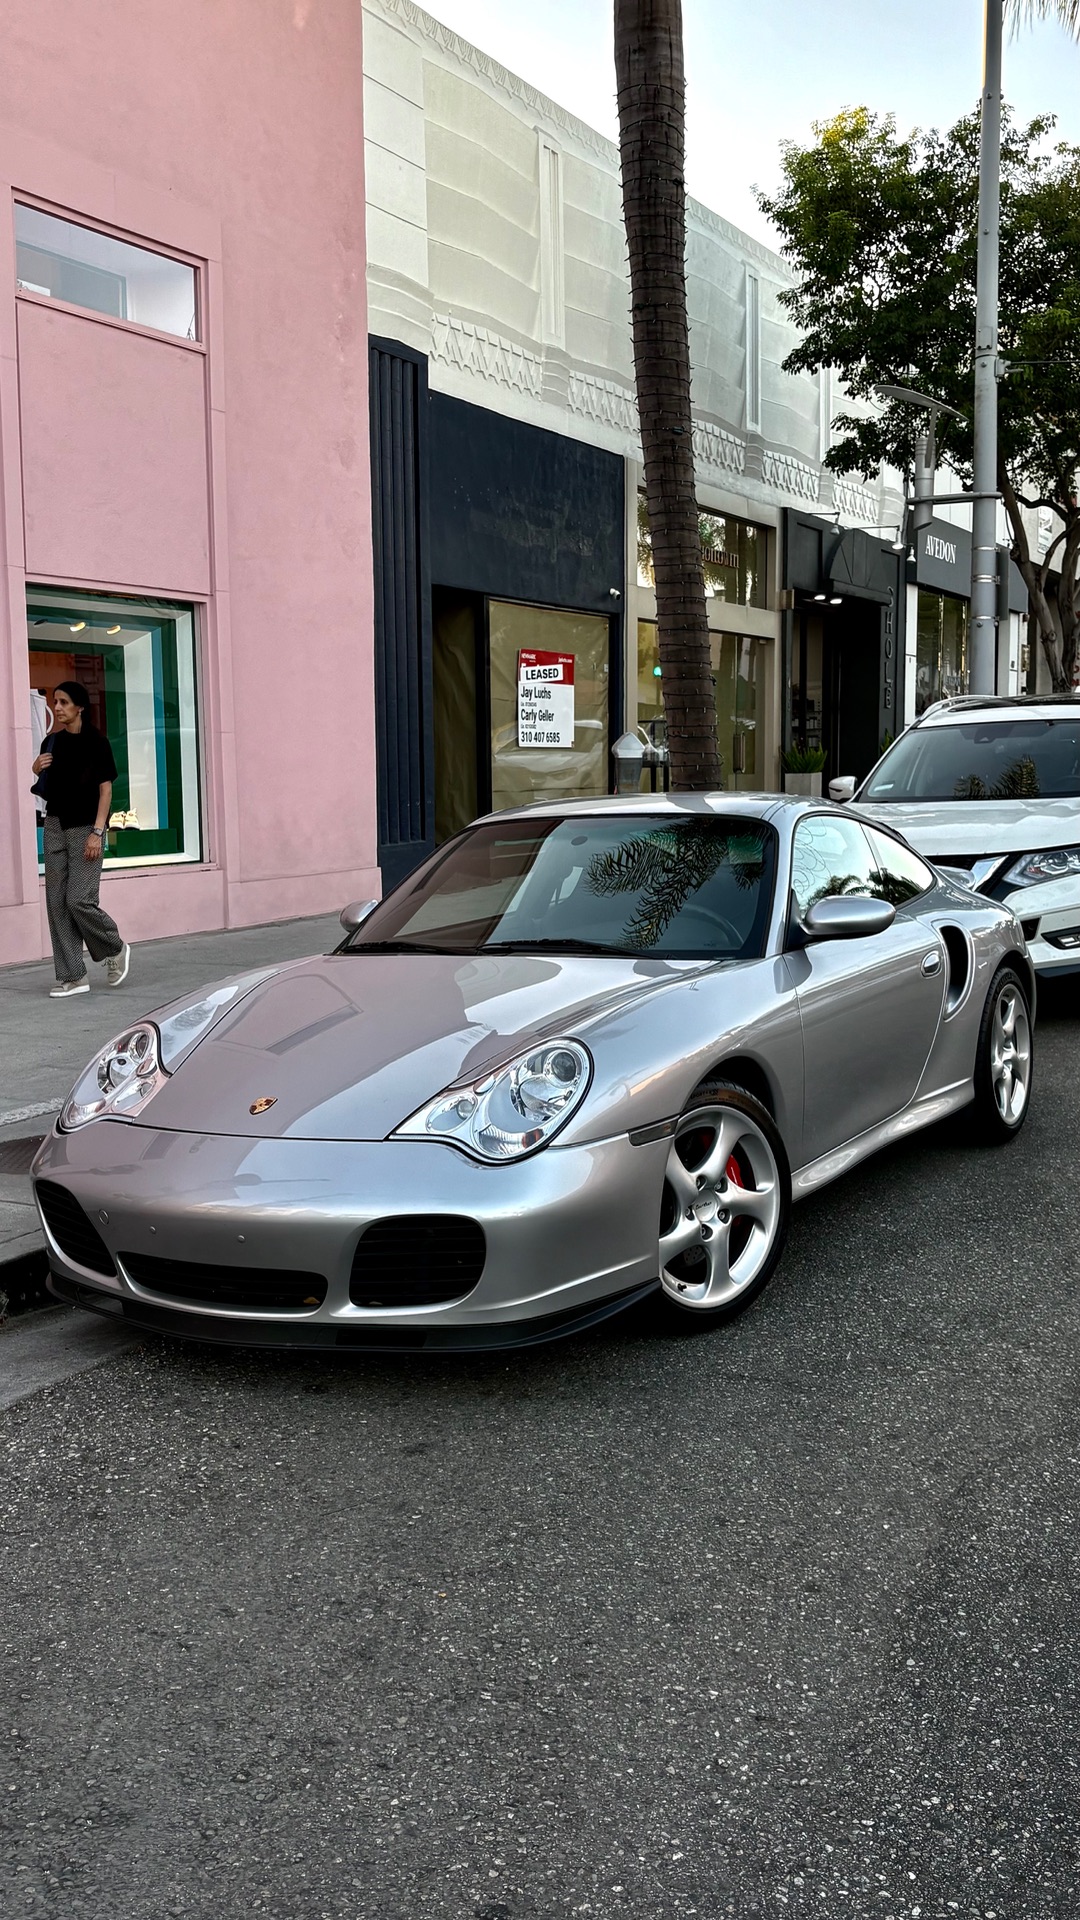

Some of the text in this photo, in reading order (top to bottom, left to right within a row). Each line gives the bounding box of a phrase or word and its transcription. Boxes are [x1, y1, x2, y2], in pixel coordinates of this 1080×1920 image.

[925, 534, 956, 564] AVEDON
[526, 668, 559, 680] LEASED
[521, 686, 551, 701] Jay Luchs
[521, 709, 554, 723] Carly Geller
[521, 731, 560, 743] 310 407 6585
